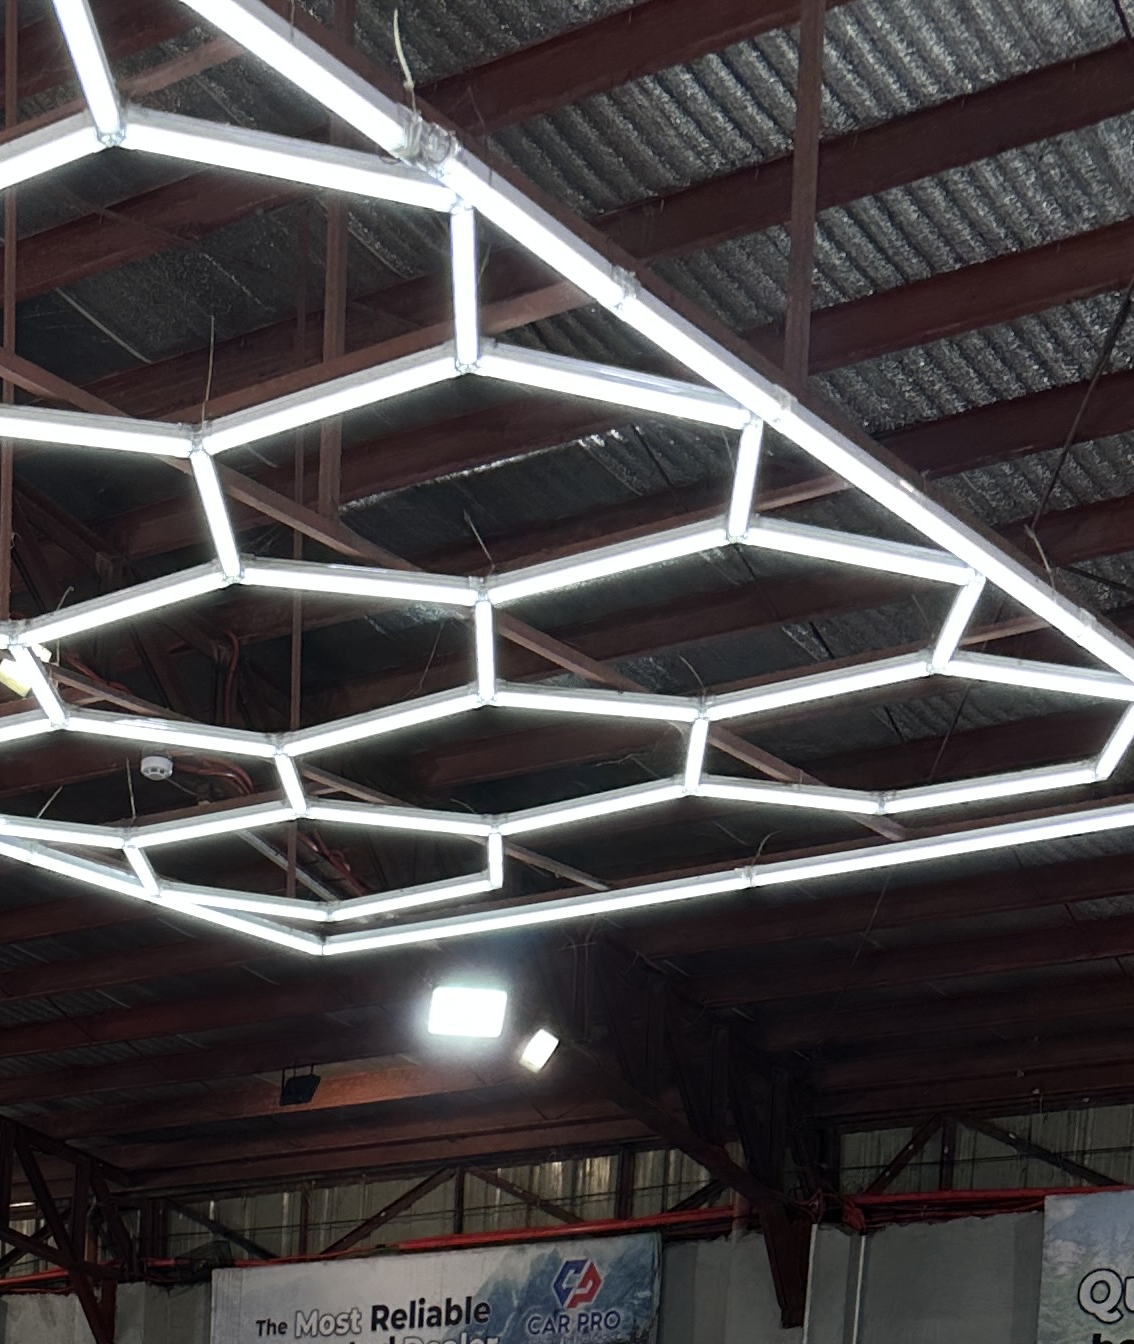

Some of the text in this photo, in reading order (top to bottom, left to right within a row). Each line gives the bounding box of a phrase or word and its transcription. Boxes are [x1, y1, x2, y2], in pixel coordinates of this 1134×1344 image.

[255, 1297, 491, 1338] The Most Reliable
[527, 1310, 621, 1335] CAR PRO
